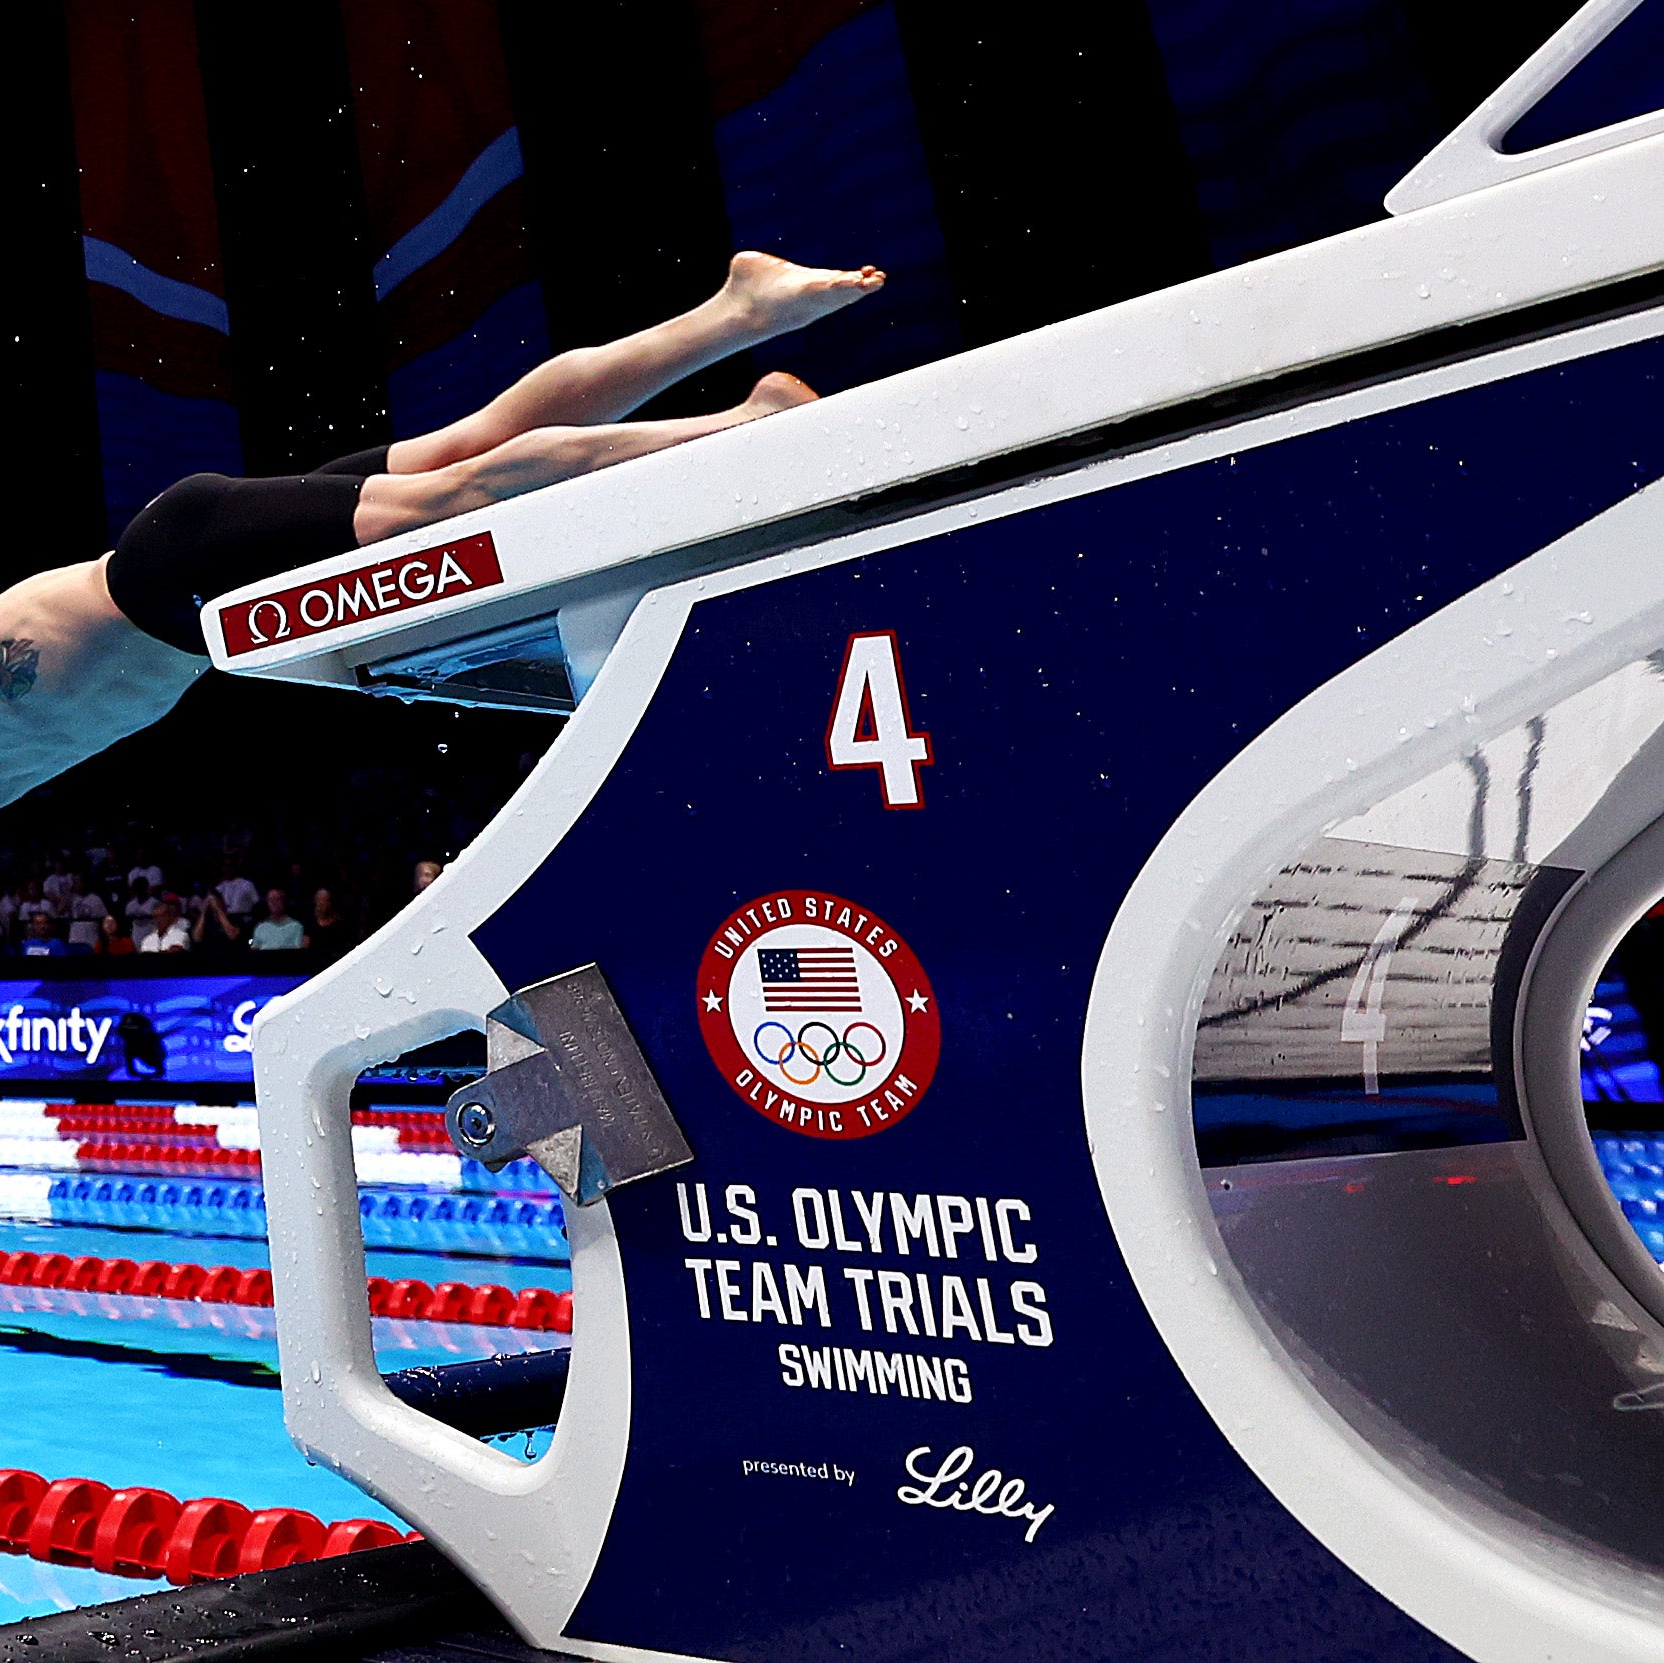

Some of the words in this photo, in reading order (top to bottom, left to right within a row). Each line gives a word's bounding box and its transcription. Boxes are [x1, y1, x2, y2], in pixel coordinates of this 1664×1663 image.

[298, 551, 474, 630] OMEGA
[827, 629, 935, 810] 4
[714, 896, 794, 961] UNITED
[804, 896, 900, 959] STATES
[735, 1068, 845, 1134] OLYMPIC
[856, 1073, 920, 1130] TEAM
[676, 1181, 779, 1249] U.S.
[793, 1187, 1040, 1265] OLYMPIC
[684, 1256, 833, 1328] TEAM
[843, 1268, 1055, 1349] TRIALS
[778, 1343, 973, 1405] SWIMMING
[741, 1457, 830, 1483] presented
[832, 1461, 857, 1488] by
[897, 1444, 1056, 1544] Lilly
